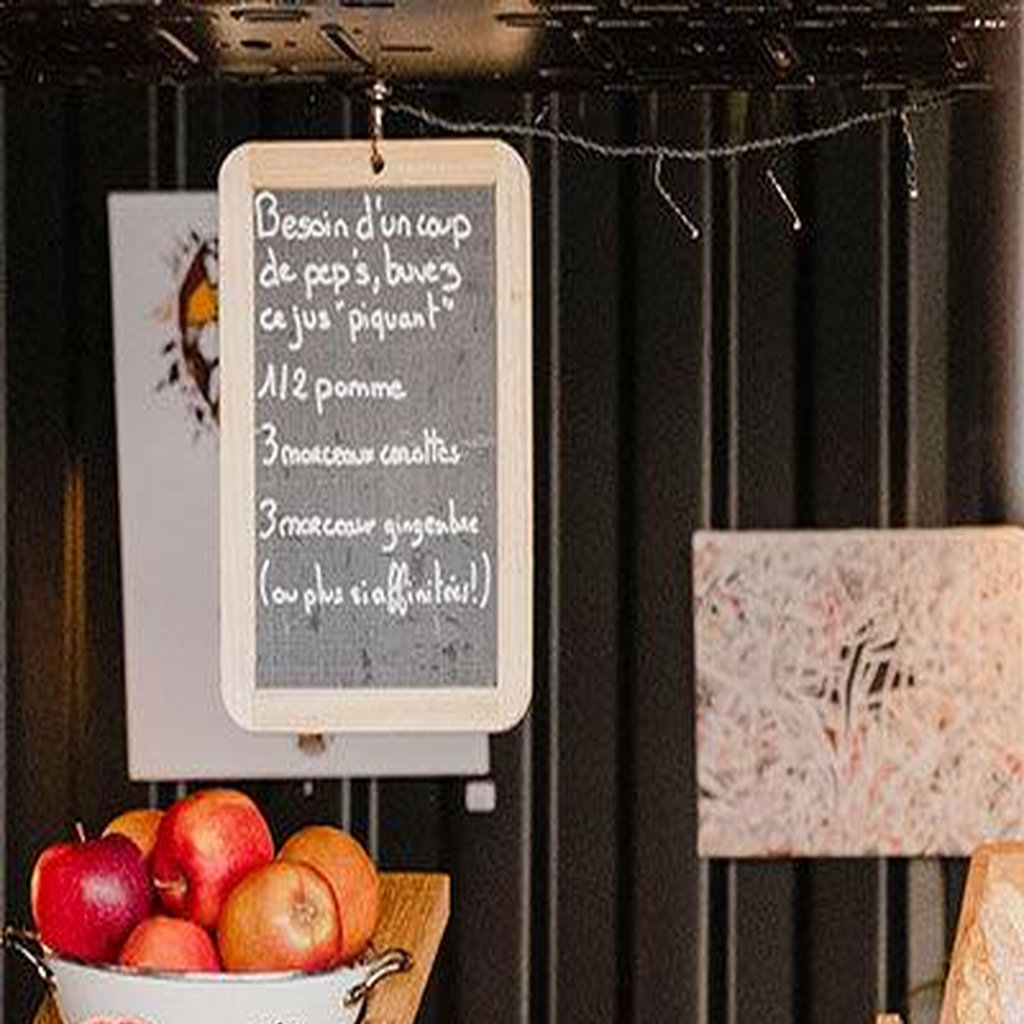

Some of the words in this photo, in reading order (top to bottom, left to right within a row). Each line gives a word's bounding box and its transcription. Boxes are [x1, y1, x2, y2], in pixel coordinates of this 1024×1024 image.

[255, 190, 348, 240] Besoin
[356, 193, 411, 239] d'un
[417, 212, 472, 249] coup
[259, 247, 297, 288] de
[383, 242, 462, 291] buvez
[259, 306, 287, 330] ce
[288, 305, 331, 350] jus
[315, 377, 407, 415] pomme
[261, 423, 278, 465] 3
[259, 499, 277, 539] 3
[260, 559, 298, 606] (ou
[303, 562, 343, 614] plus
